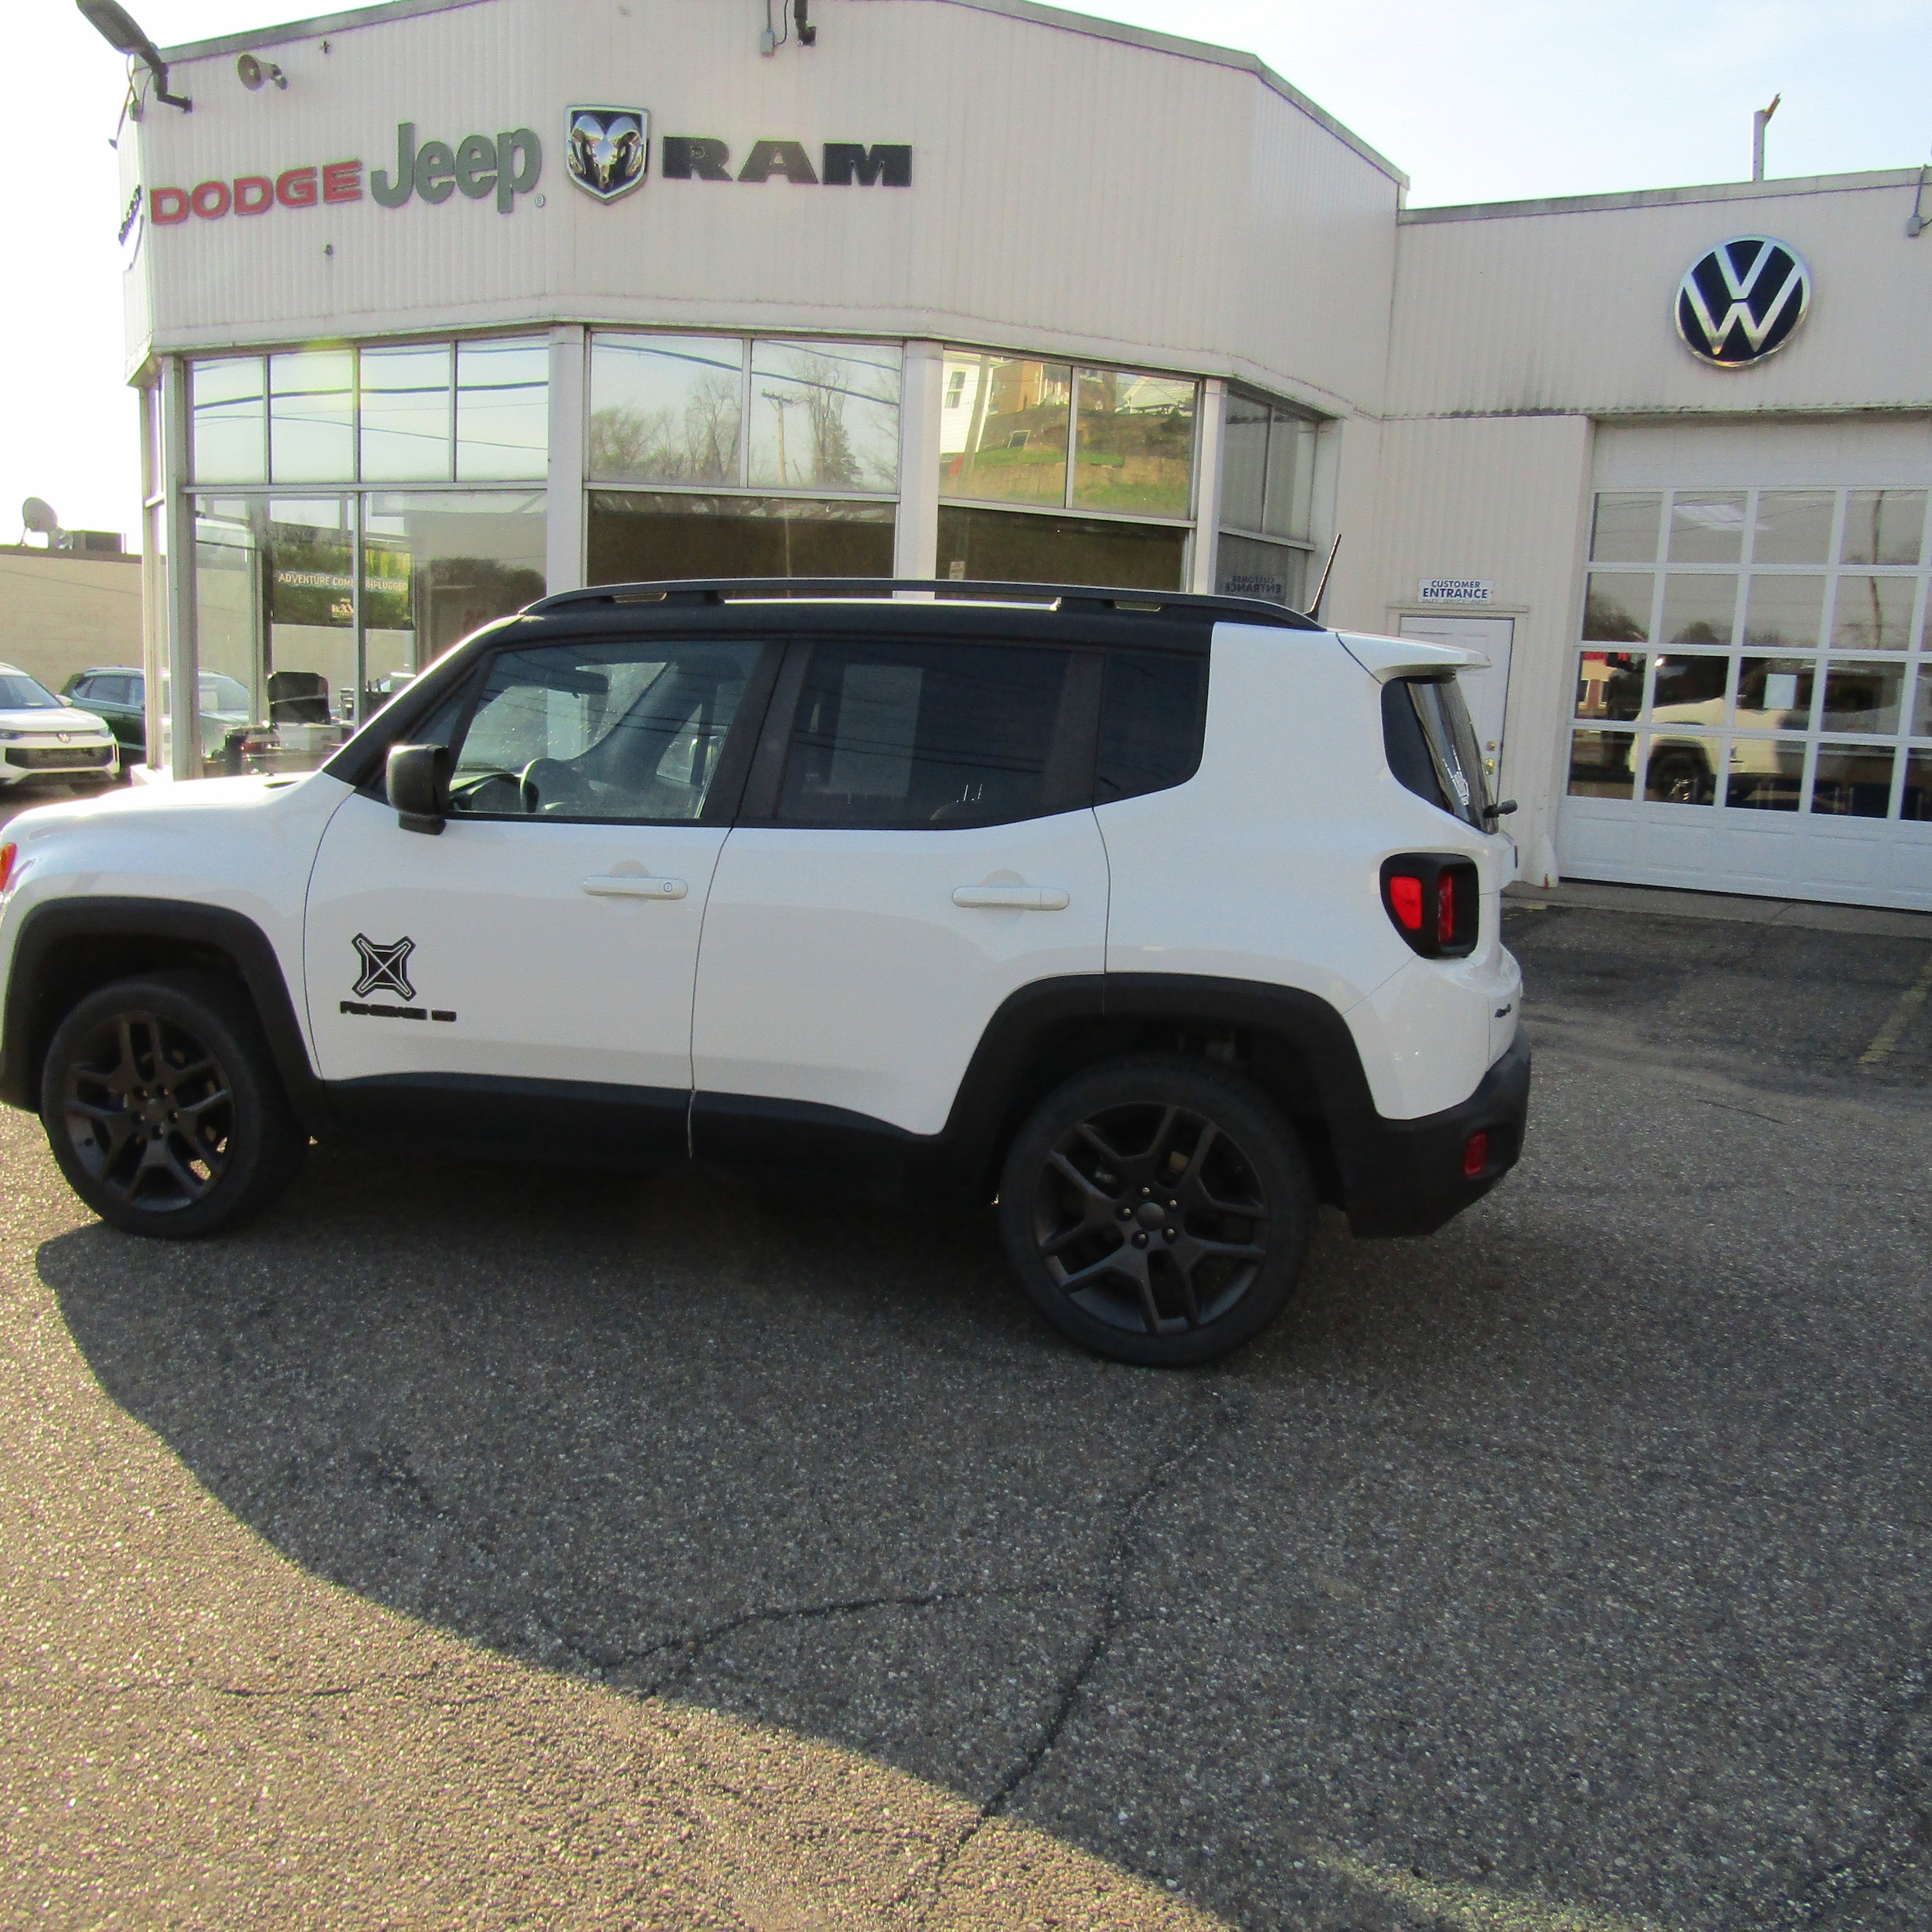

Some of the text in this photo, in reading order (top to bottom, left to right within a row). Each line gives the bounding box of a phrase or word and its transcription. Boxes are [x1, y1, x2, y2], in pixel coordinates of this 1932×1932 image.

[371, 121, 543, 214] Jeep
[662, 135, 913, 186] RAM
[150, 158, 363, 226] DODGE
[1678, 237, 1808, 361] VW
[278, 573, 330, 586] ADVENTURE
[332, 577, 354, 587] COME
[1423, 587, 1488, 599] ENTRANCE
